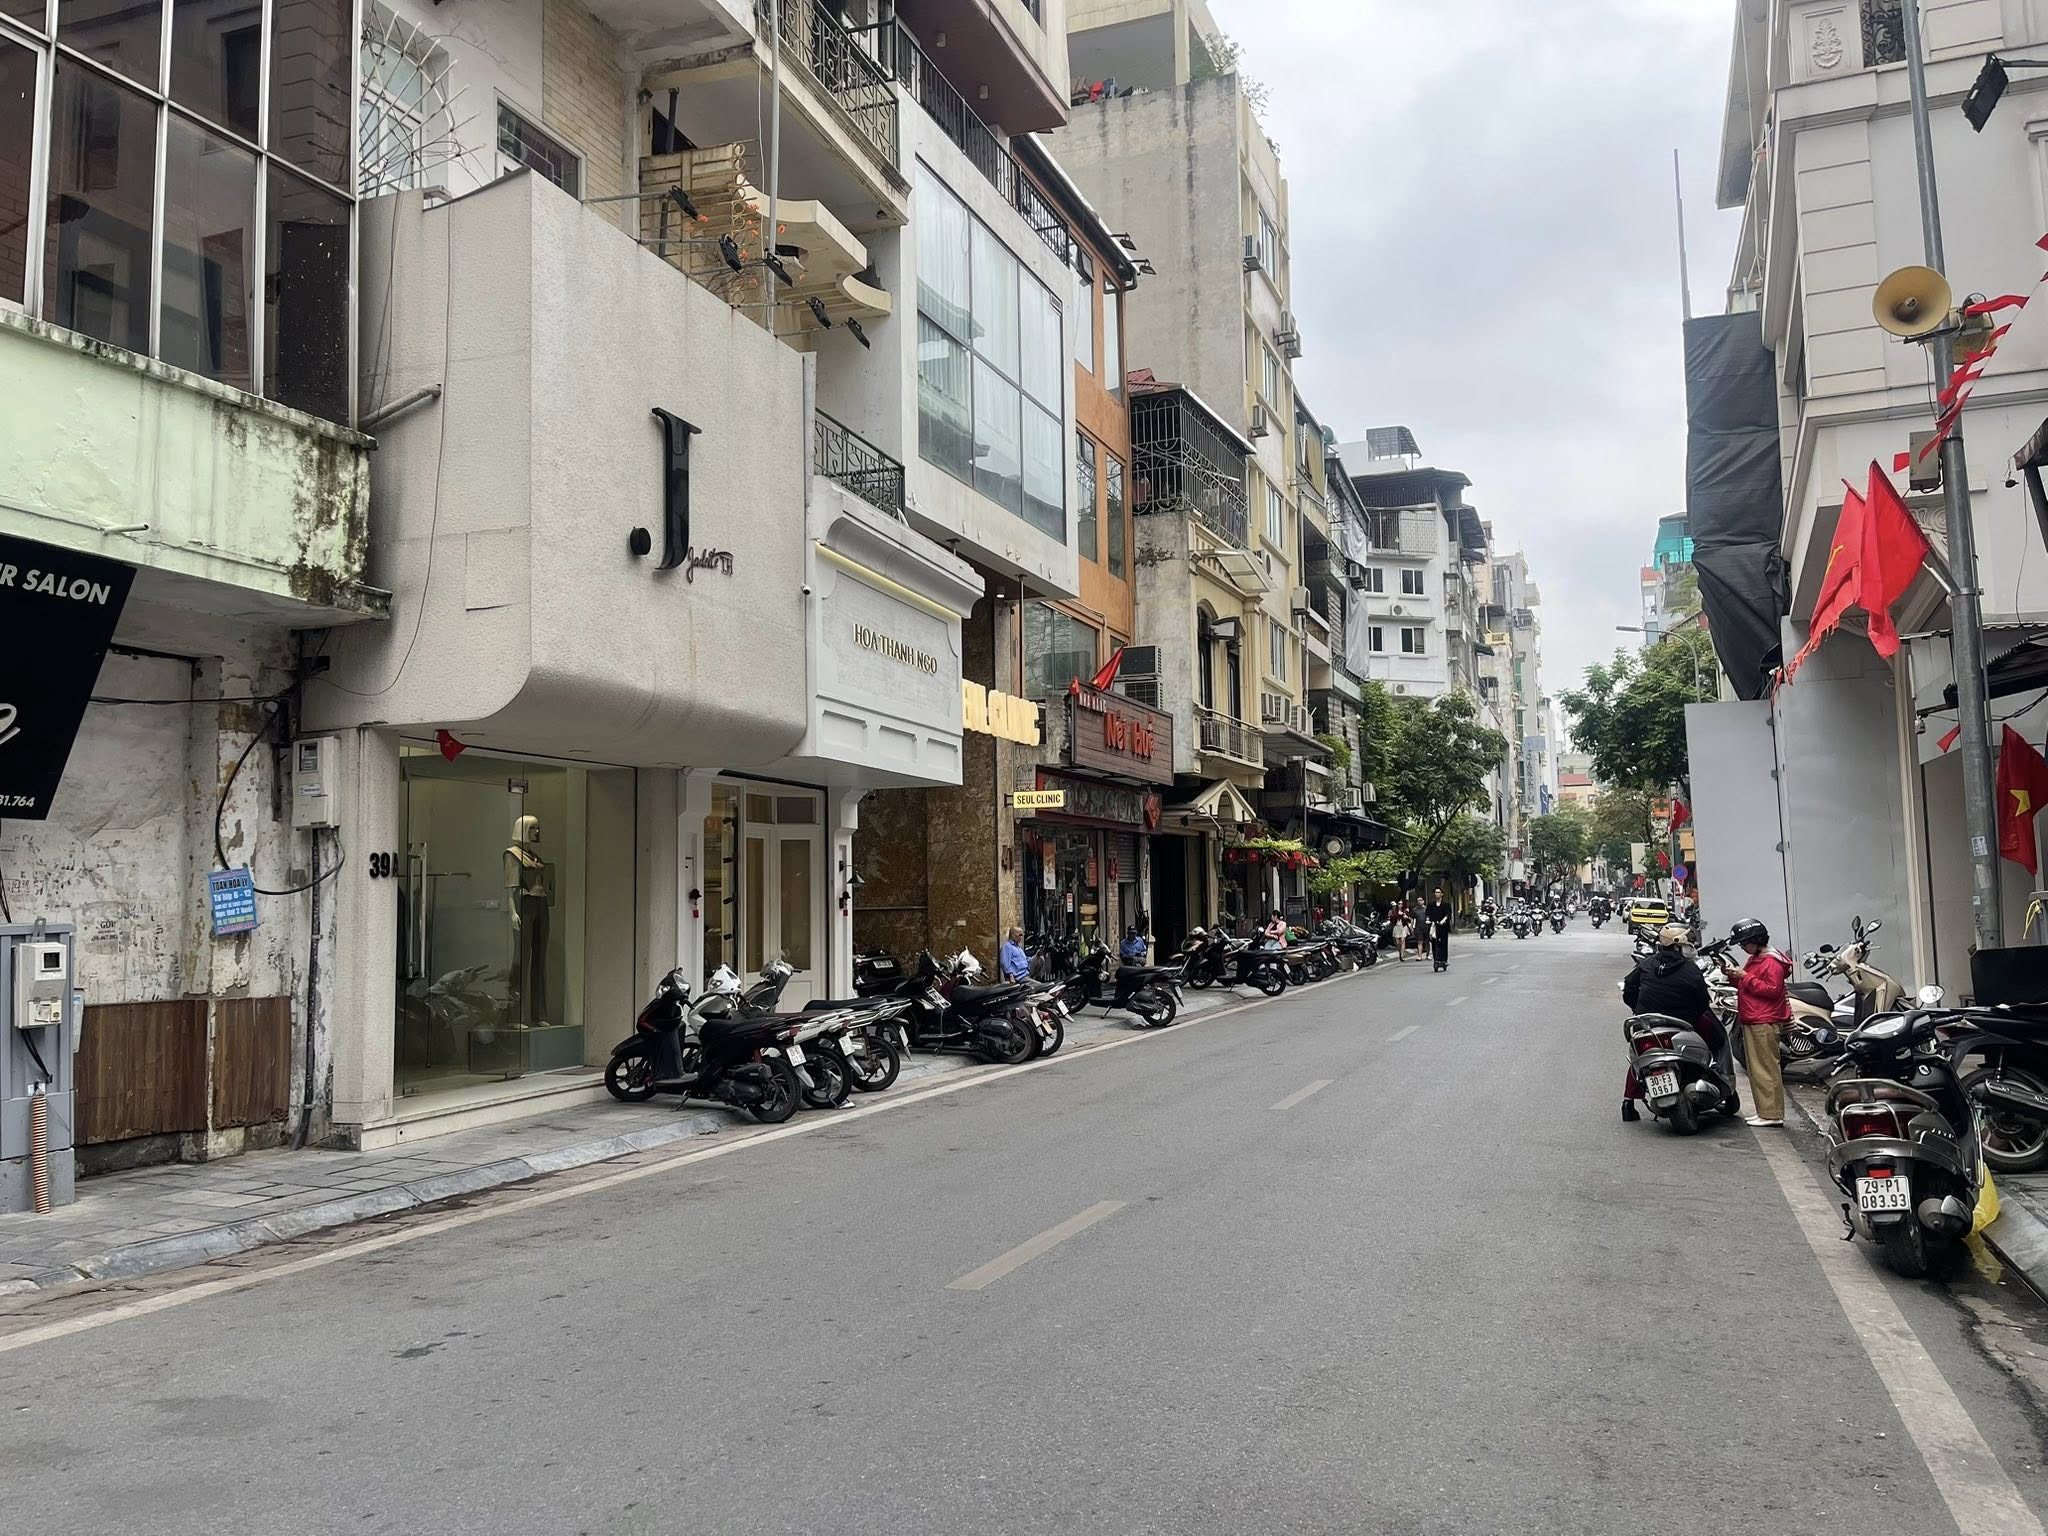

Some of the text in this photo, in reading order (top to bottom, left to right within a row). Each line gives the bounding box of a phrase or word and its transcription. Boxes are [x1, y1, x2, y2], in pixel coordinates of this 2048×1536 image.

[22, 569, 111, 605] SALON
[853, 623, 938, 676] HOA THANH NGO
[1016, 794, 1061, 805] SEUL CLINIC
[369, 852, 399, 878] 39A
[1864, 1179, 1900, 1194] 29-P1
[1861, 1193, 1907, 1209] 083.93
